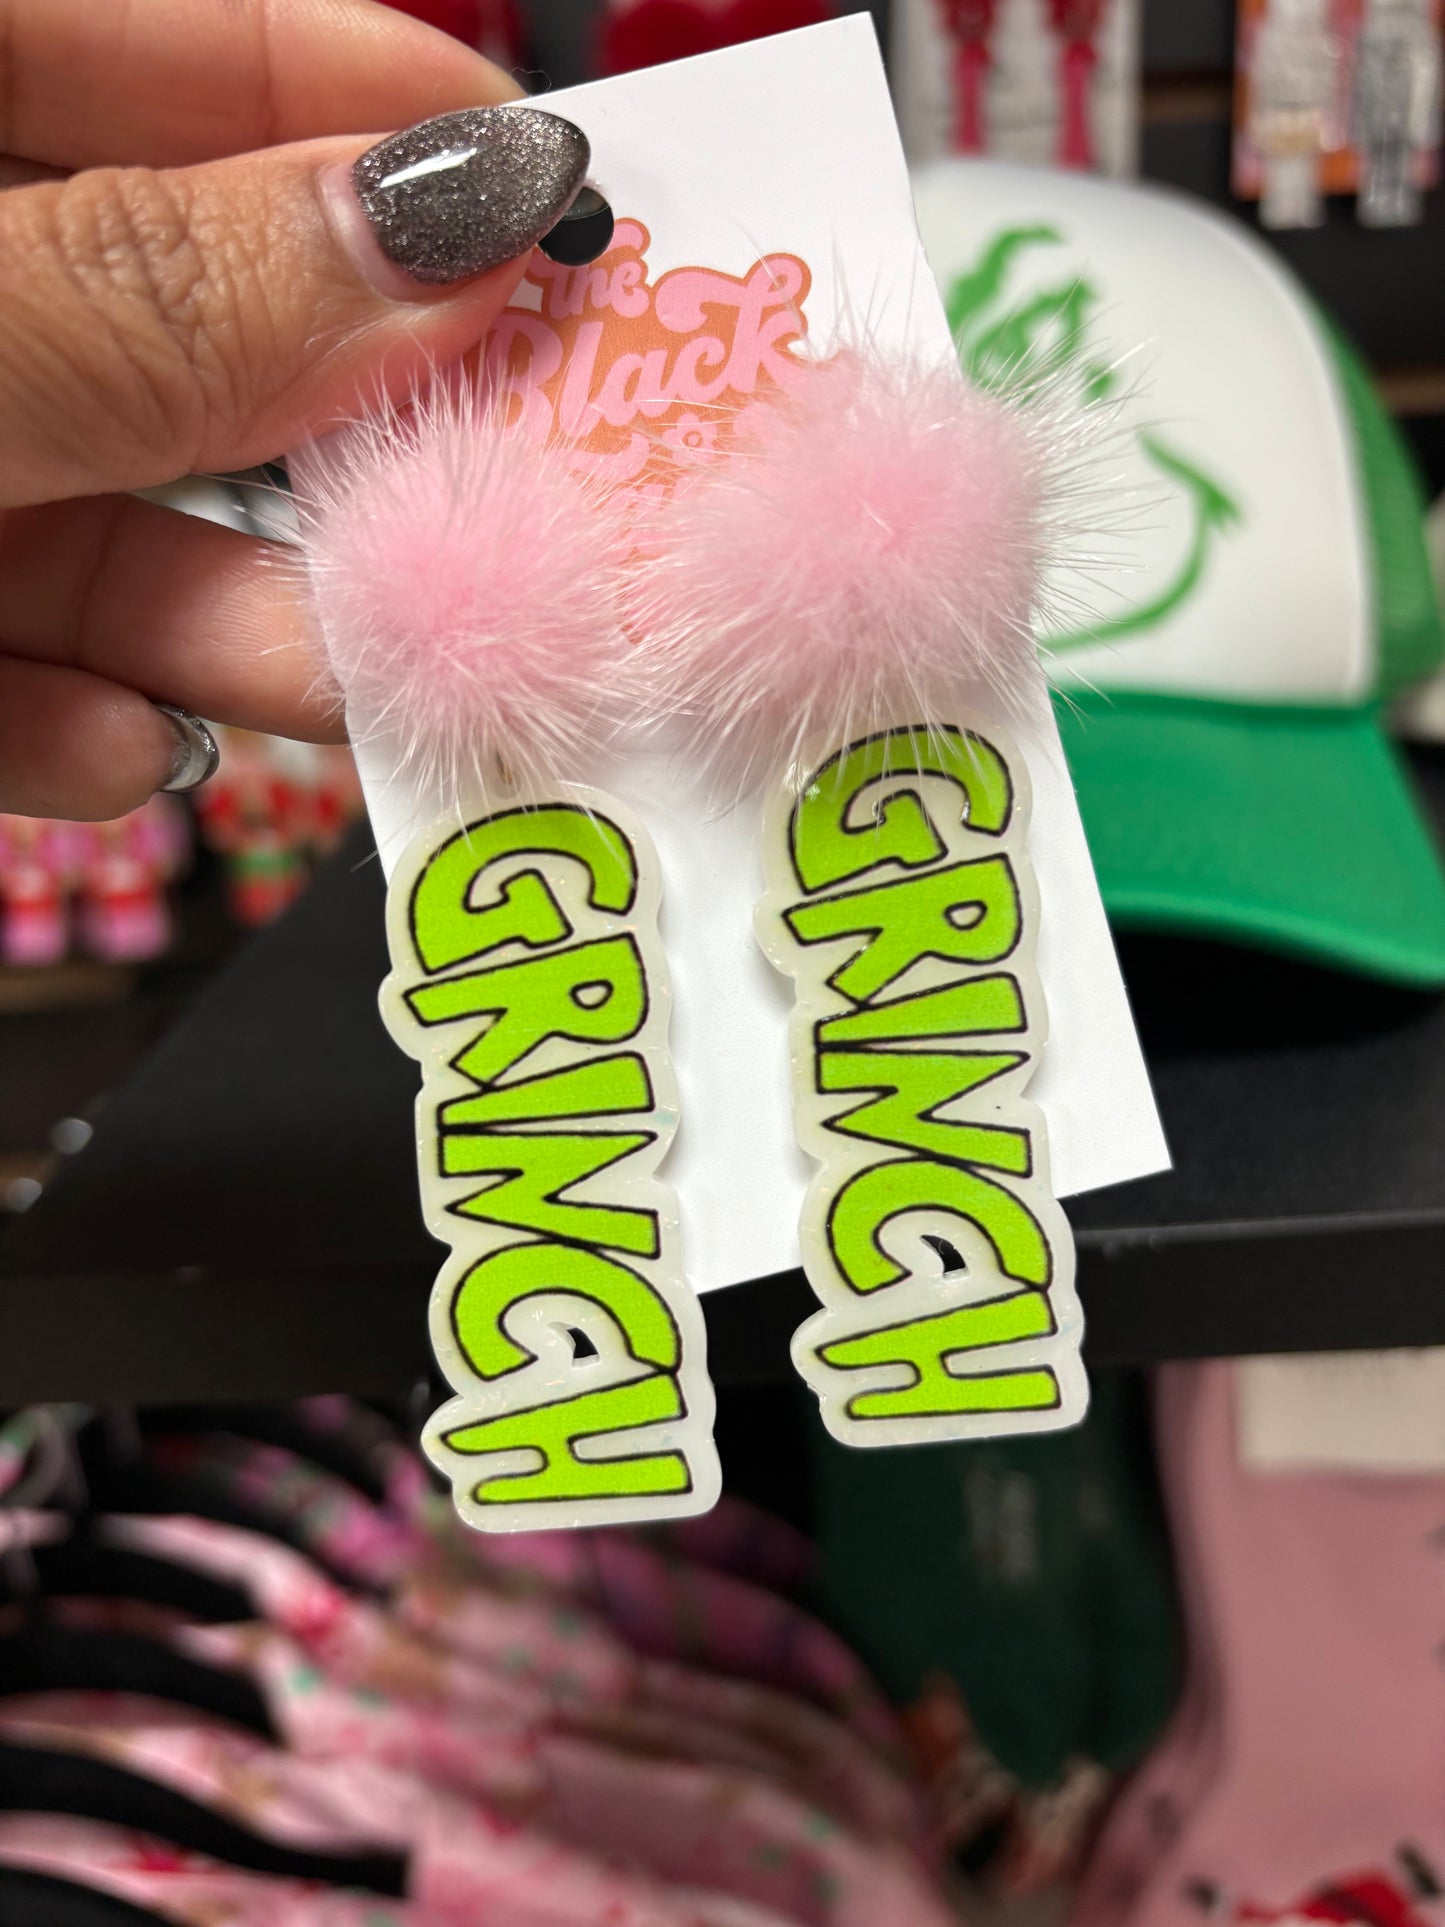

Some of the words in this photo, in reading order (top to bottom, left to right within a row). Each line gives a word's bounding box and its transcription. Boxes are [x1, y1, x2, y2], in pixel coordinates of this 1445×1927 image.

[465, 254, 808, 447] Black
[402, 803, 693, 1506] GRINCH
[782, 724, 1063, 1421] GRINCH
